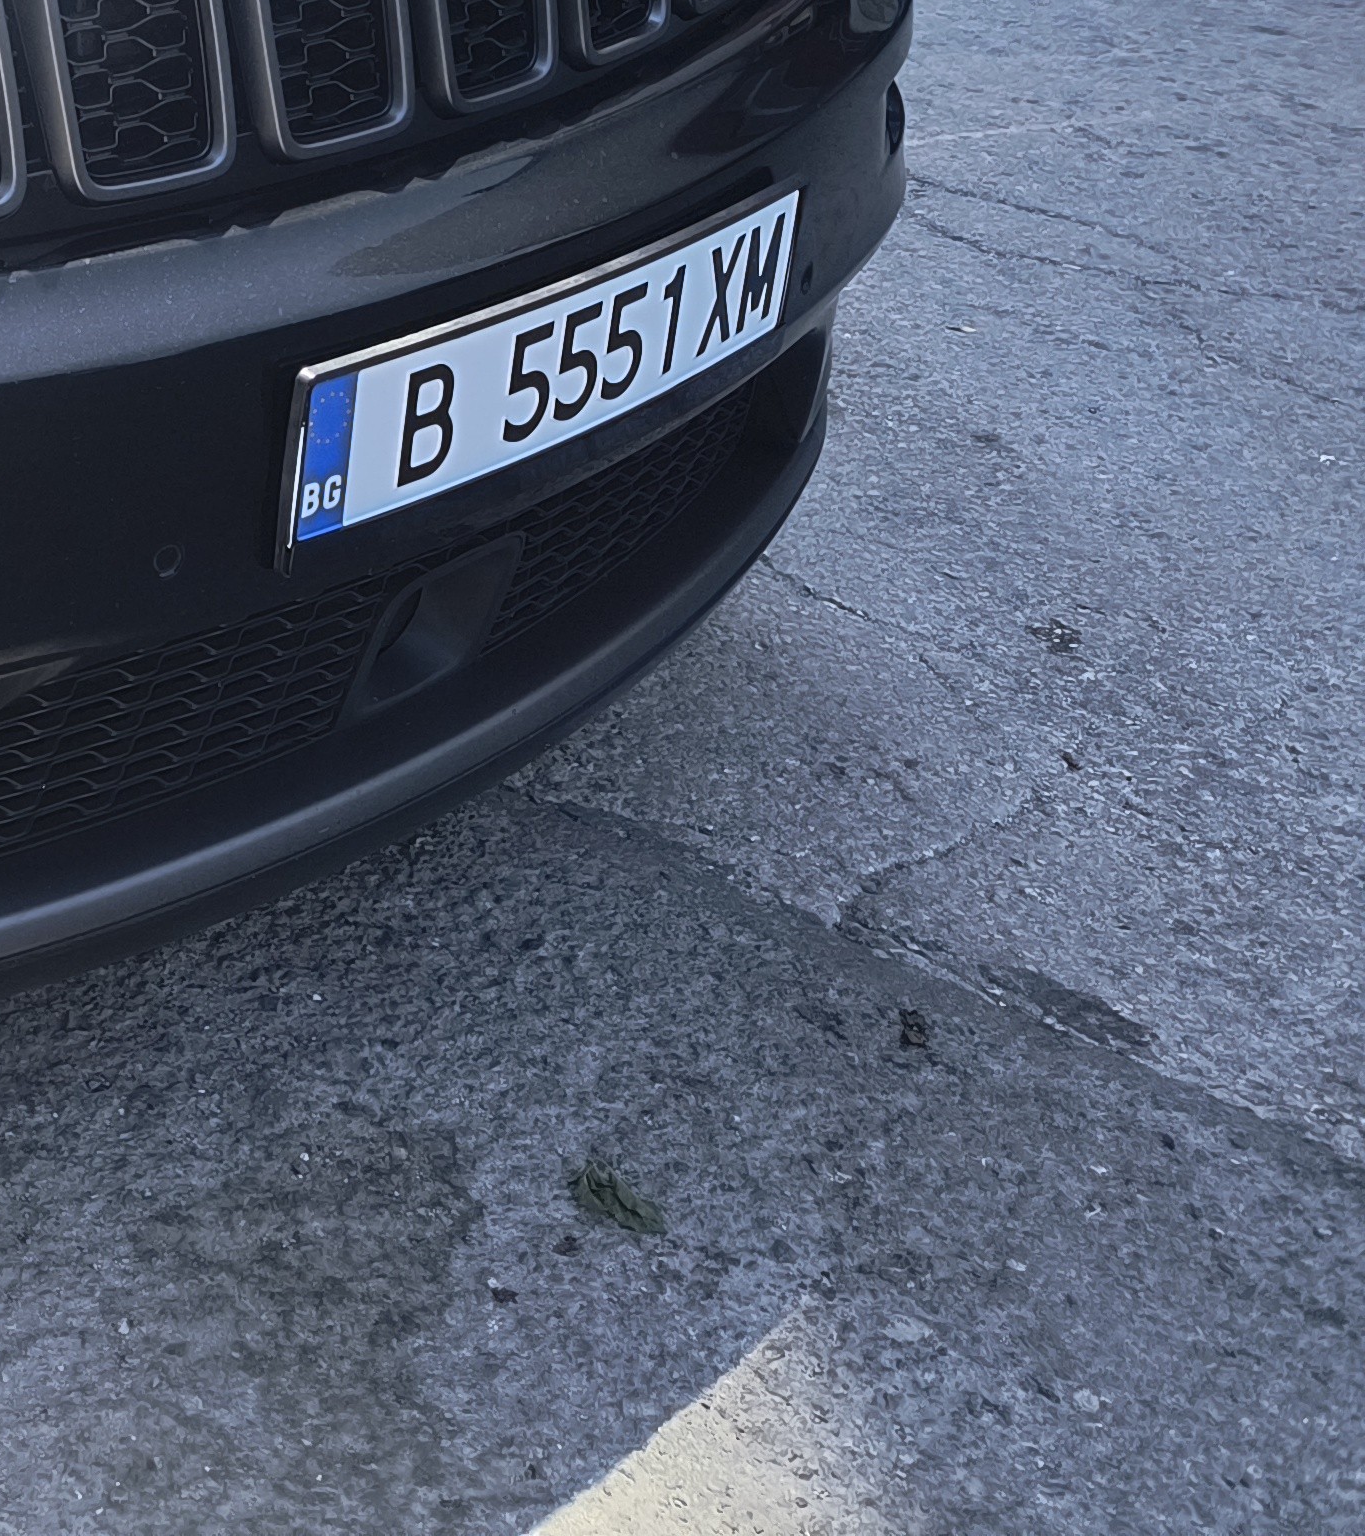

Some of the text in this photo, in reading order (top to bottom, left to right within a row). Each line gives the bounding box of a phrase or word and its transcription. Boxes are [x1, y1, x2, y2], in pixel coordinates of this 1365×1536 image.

[397, 212, 786, 487] B 5551 XM
[300, 473, 344, 519] BG
